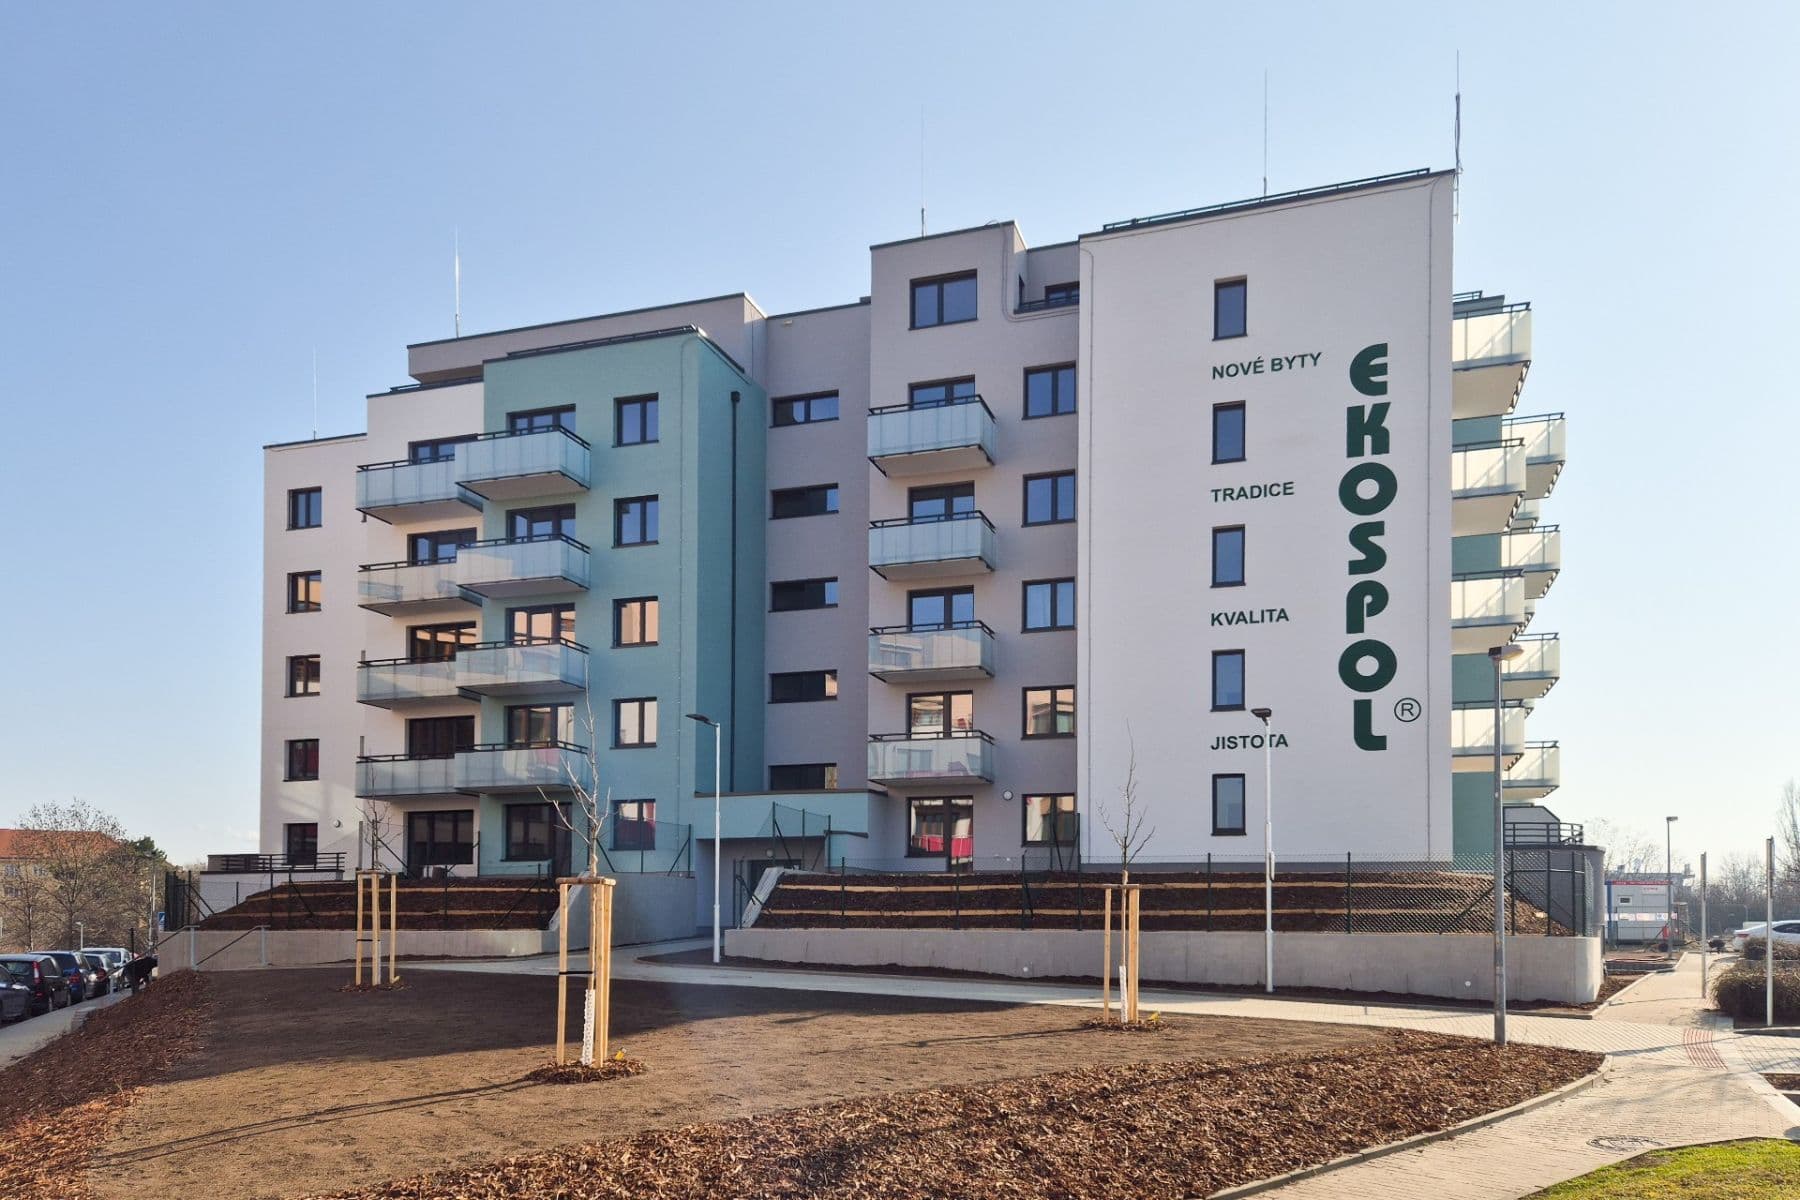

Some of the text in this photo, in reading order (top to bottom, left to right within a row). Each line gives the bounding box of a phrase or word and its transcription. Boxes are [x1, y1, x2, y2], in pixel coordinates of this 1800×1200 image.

[1212, 352, 1322, 379] NOVÉ BYTY
[1211, 481, 1295, 503] TRADICE
[1338, 342, 1398, 751] EKOSPOL
[1210, 607, 1290, 627] KVALITA
[1210, 733, 1289, 751] JISTOTA
